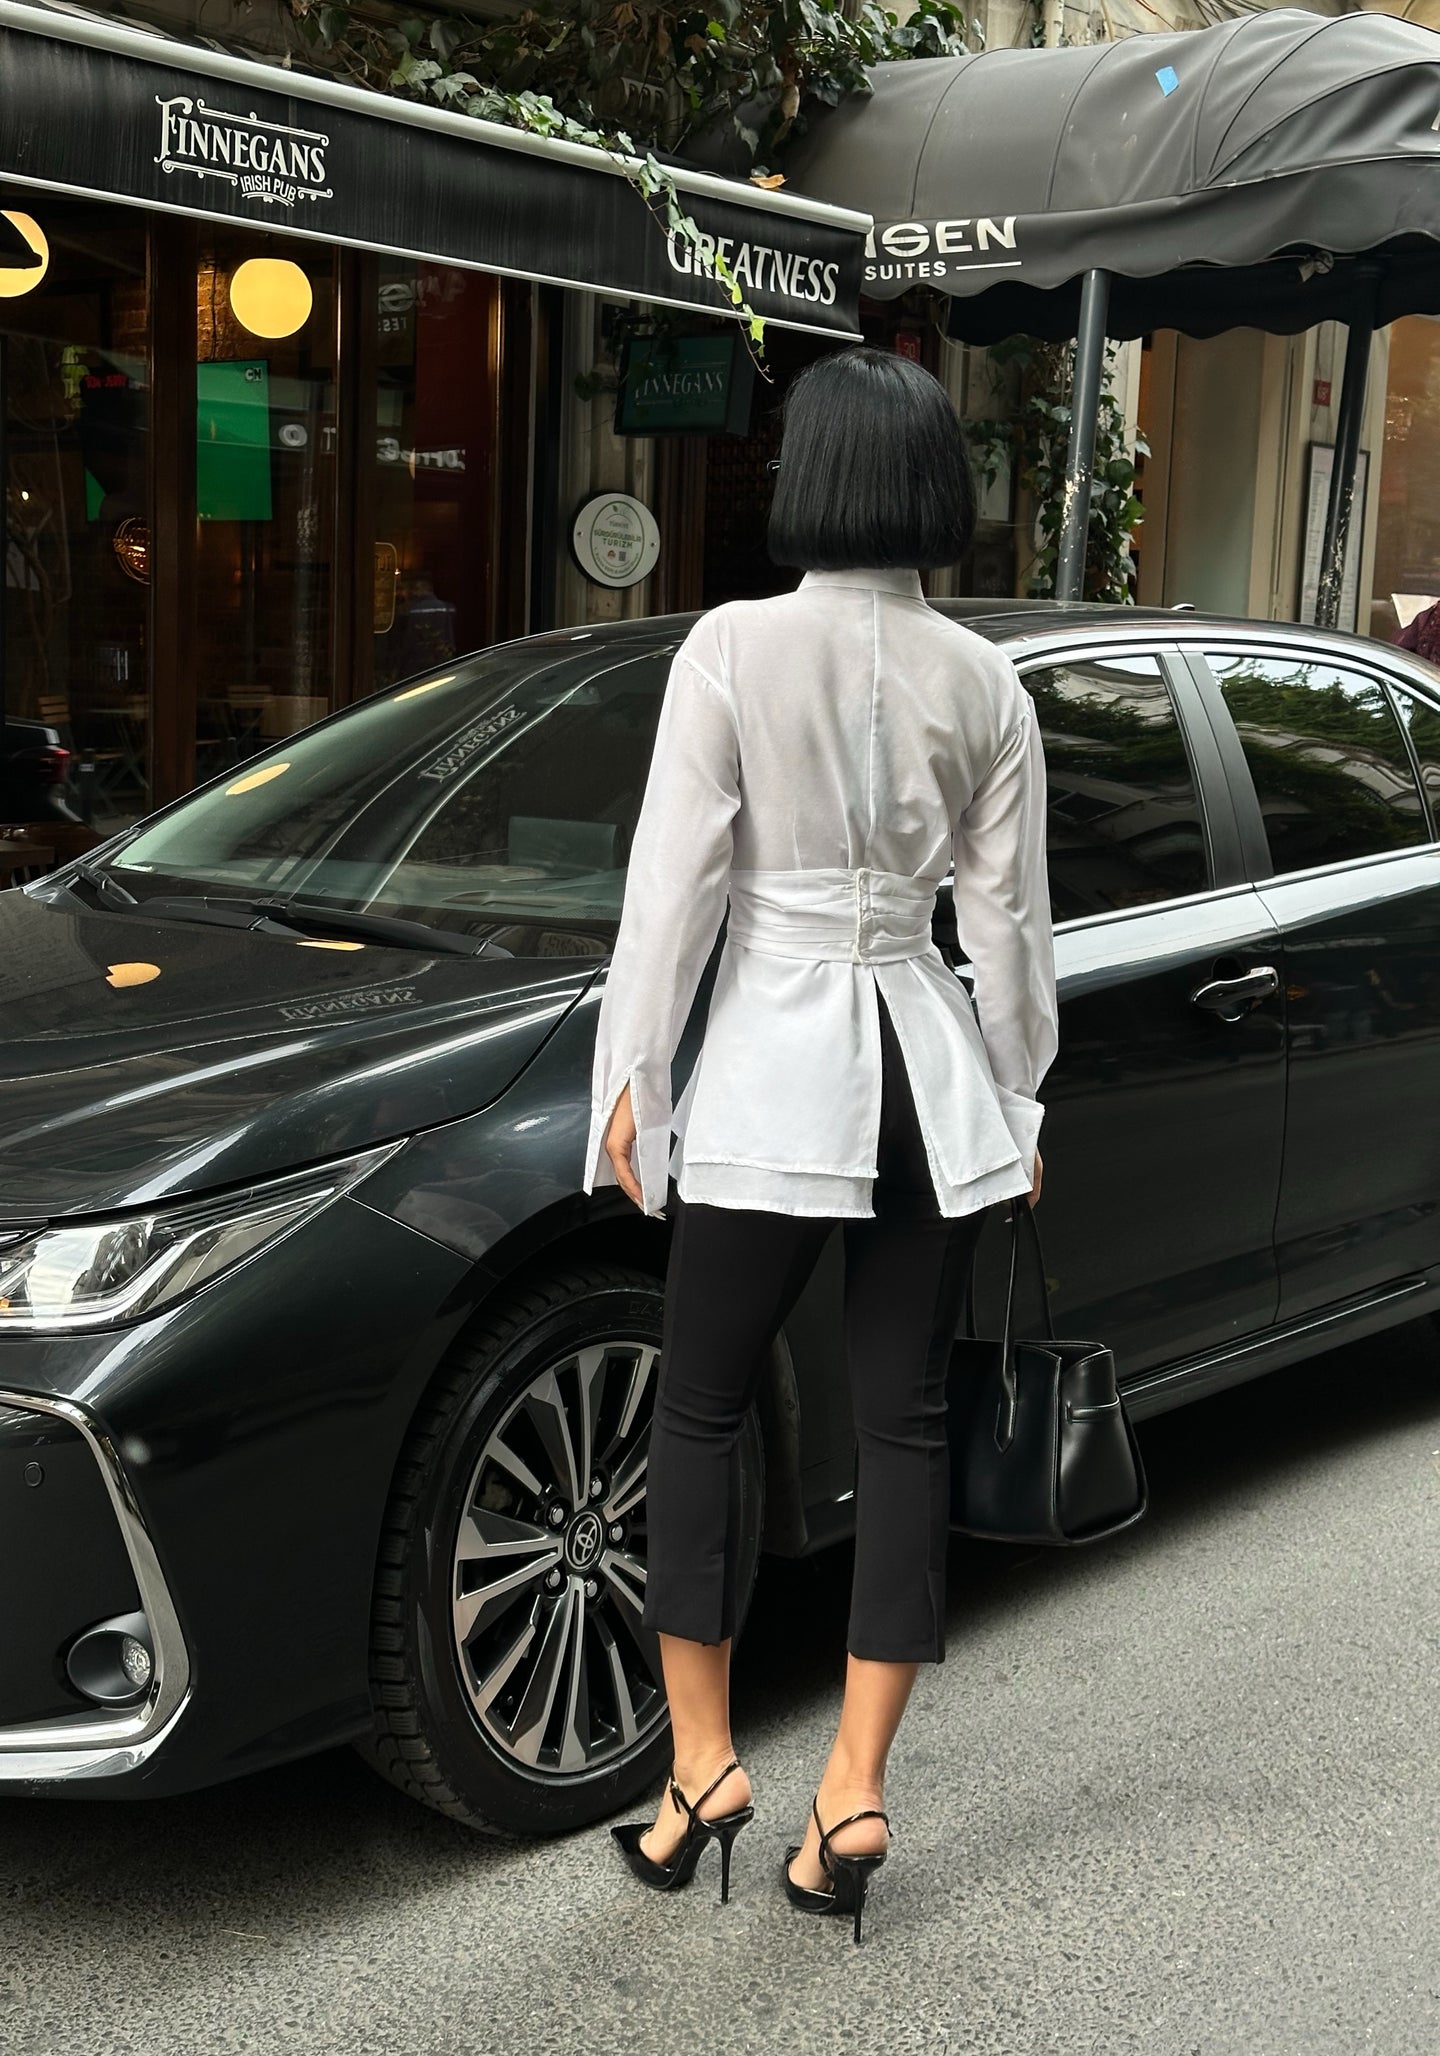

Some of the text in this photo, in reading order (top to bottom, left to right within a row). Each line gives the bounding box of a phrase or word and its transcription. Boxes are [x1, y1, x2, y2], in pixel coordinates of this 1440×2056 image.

[154, 95, 326, 183] FINNEGANS
[240, 174, 297, 202] IRISH PUB
[864, 260, 948, 281] SUITES
[634, 370, 724, 399] INNEGANS
